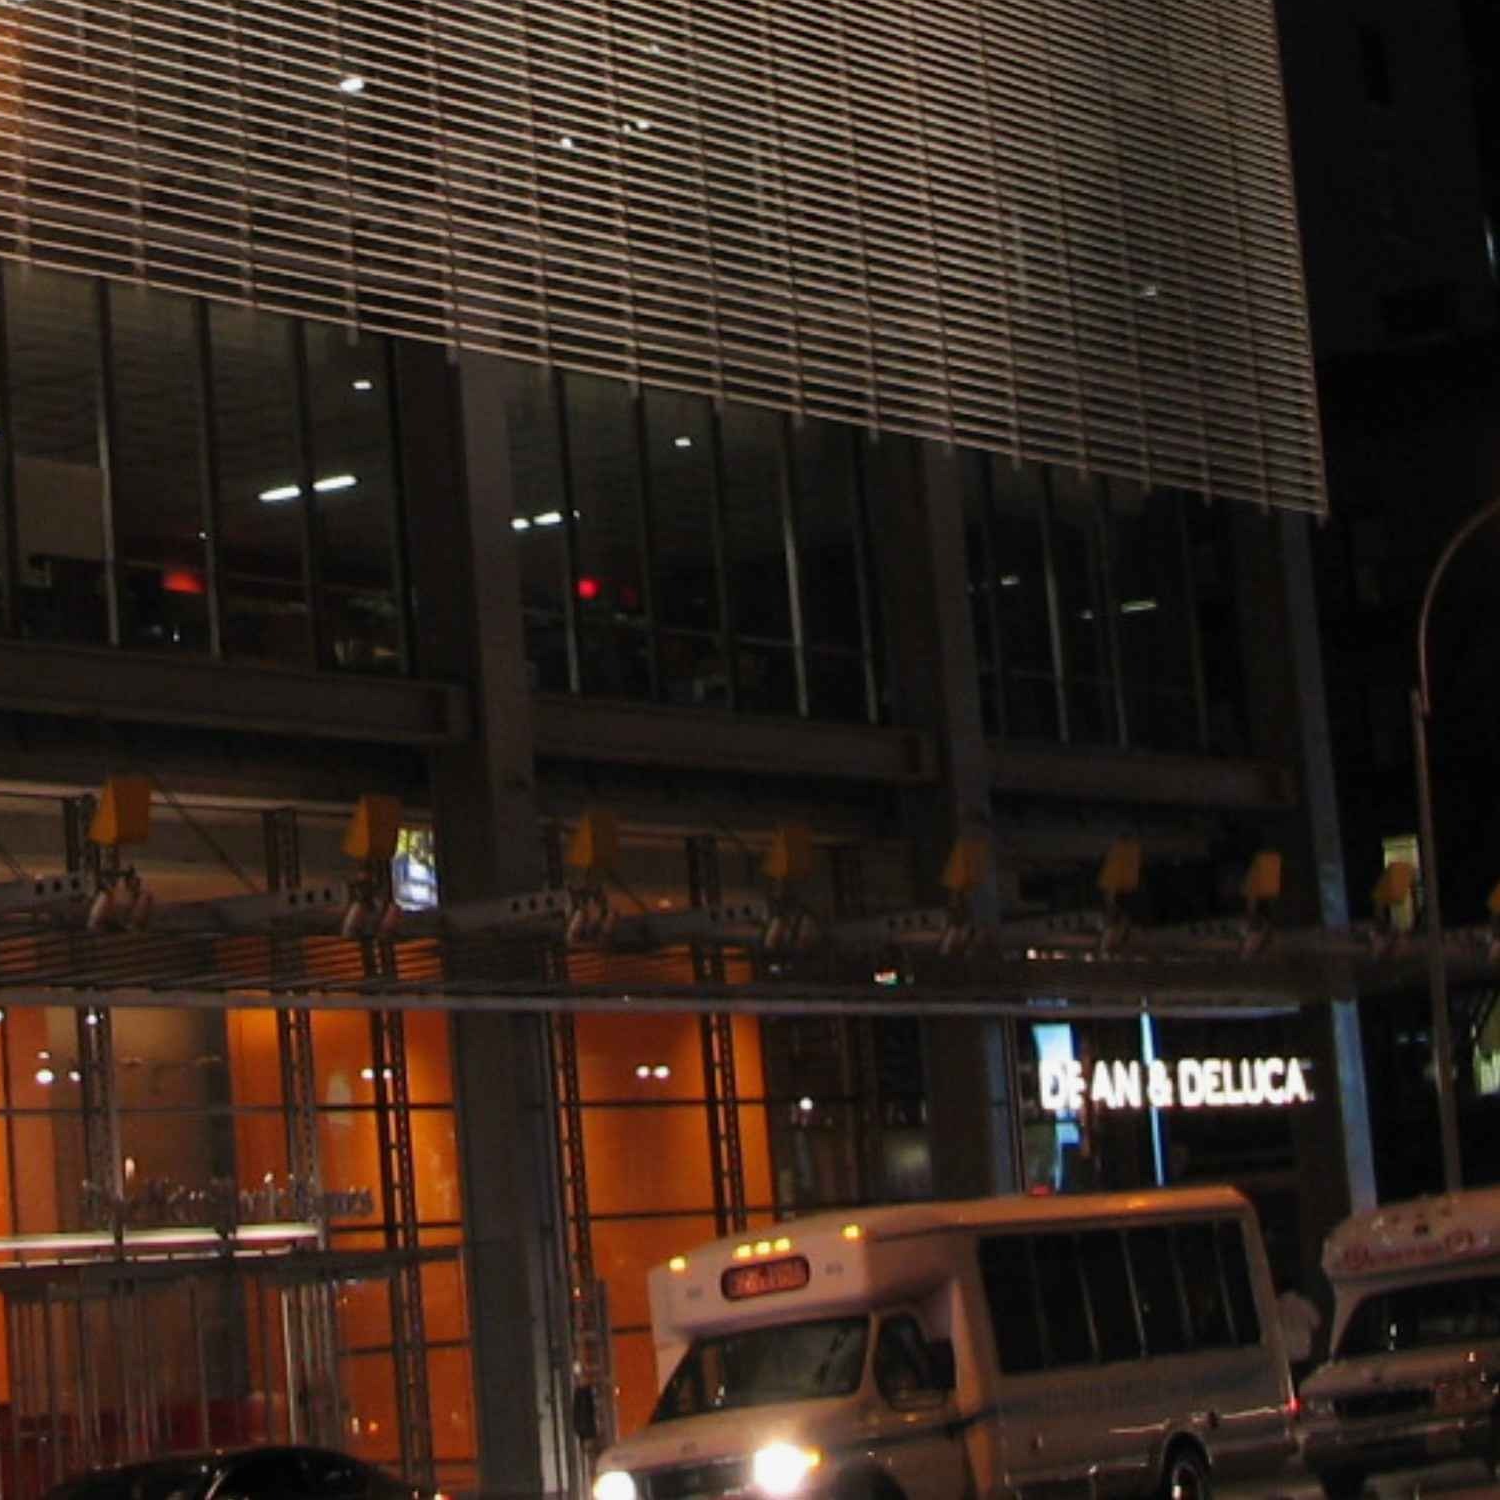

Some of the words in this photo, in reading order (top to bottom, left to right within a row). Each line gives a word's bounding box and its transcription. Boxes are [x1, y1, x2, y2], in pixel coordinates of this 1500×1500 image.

[1038, 1058, 1143, 1111] DEAN
[1146, 1057, 1174, 1109] &
[1177, 1055, 1313, 1108] DELUCA
